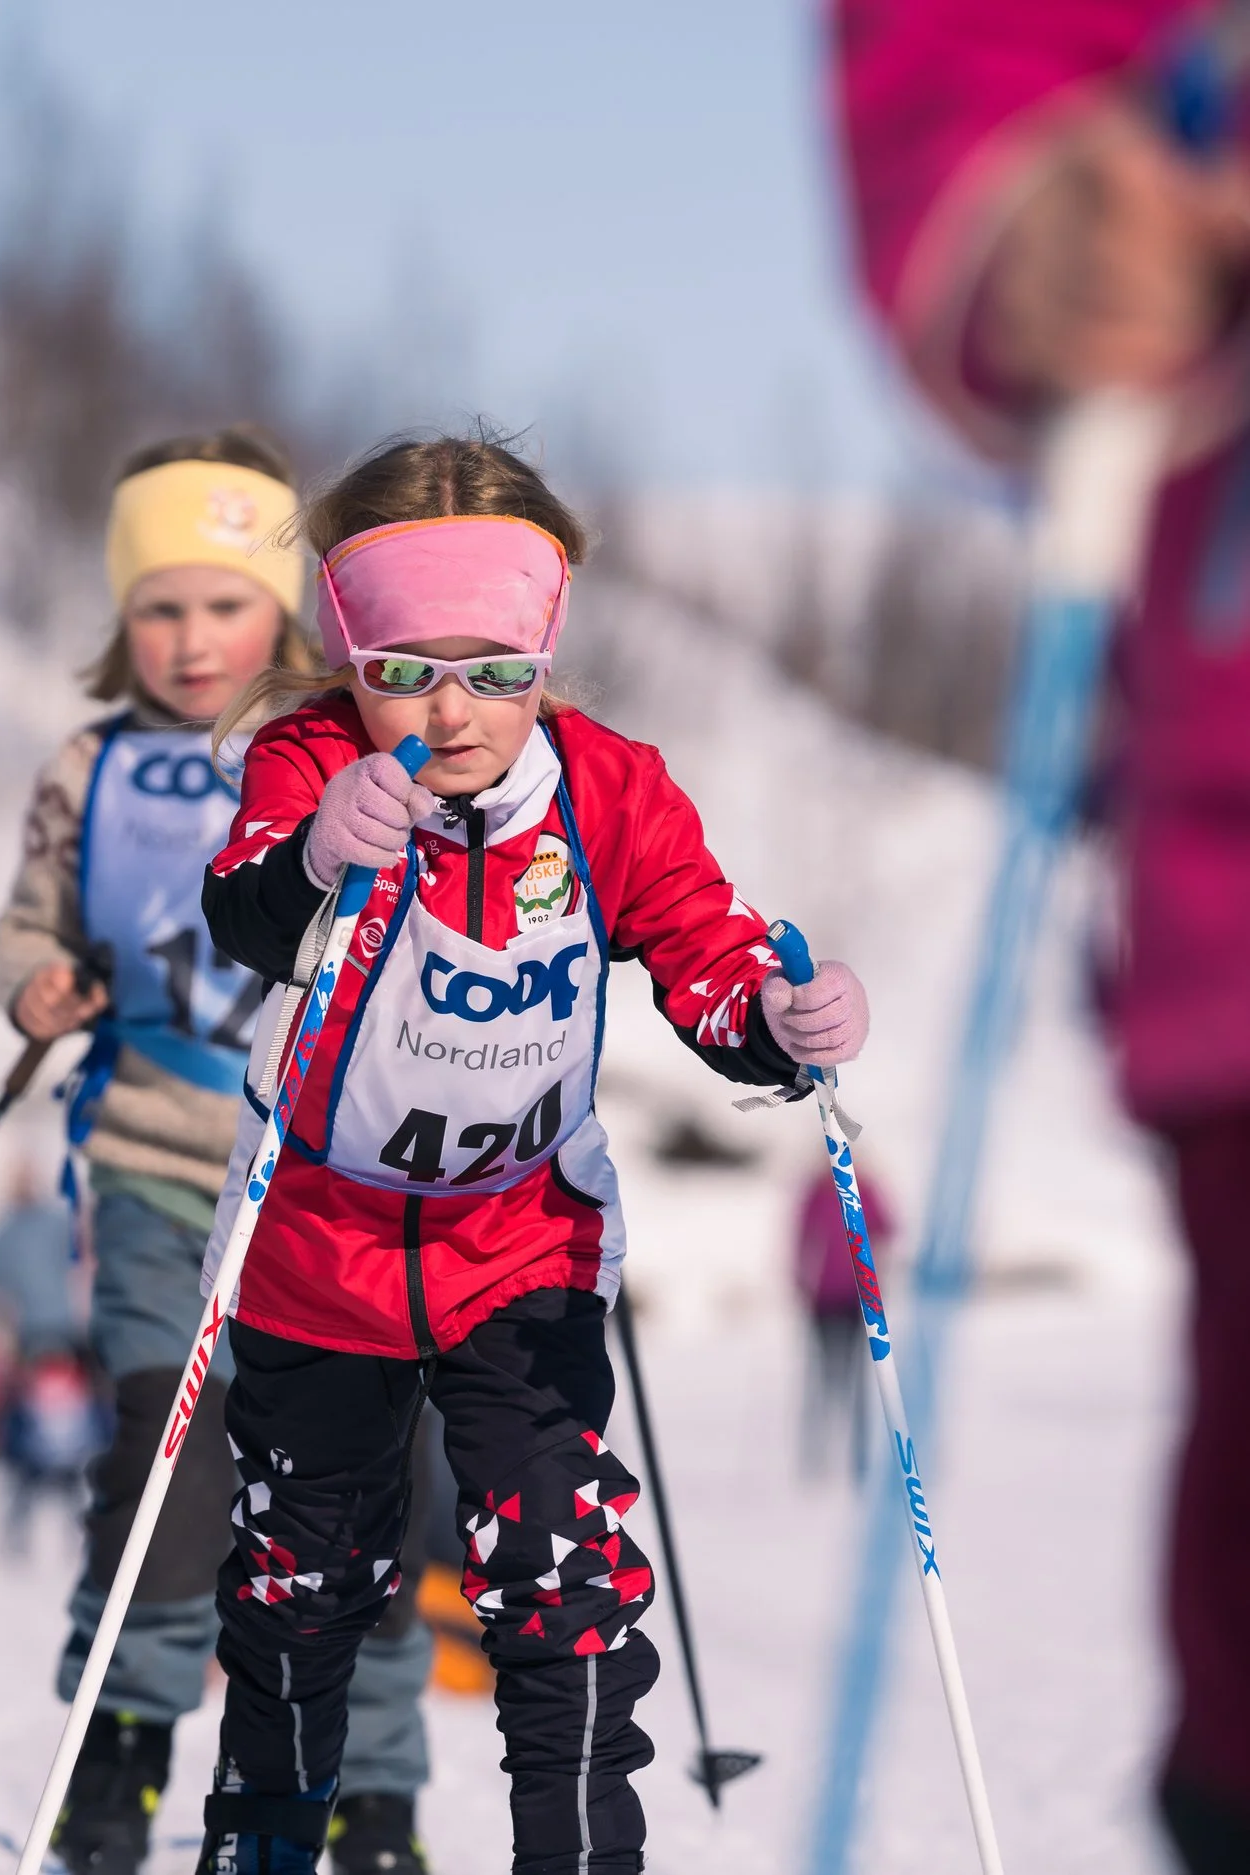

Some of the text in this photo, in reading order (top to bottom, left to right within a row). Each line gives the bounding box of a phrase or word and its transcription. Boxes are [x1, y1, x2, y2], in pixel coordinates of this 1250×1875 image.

[528, 914, 549, 924] 1902
[396, 1020, 567, 1071] Nordland
[378, 1080, 564, 1186] 420
